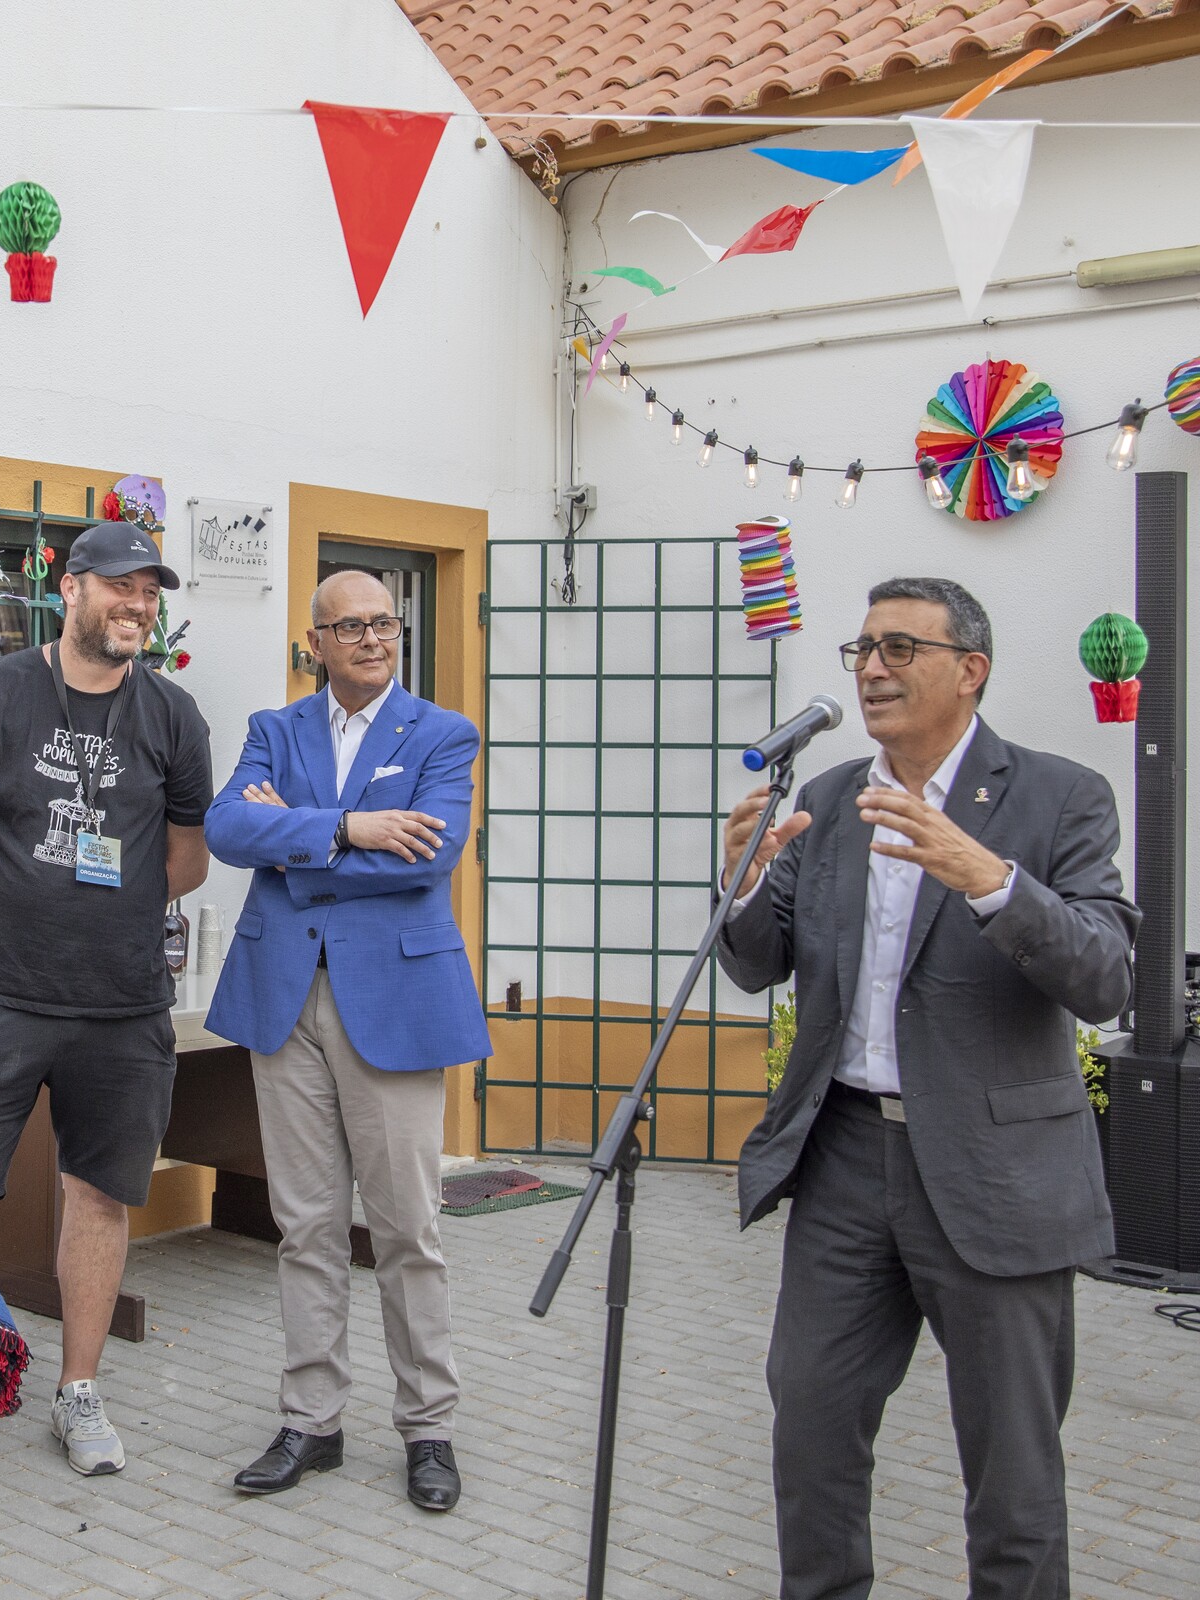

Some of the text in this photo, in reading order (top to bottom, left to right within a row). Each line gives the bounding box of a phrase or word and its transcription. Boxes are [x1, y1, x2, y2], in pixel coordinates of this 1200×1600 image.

[222, 534, 268, 551] FESTAS
[219, 556, 268, 566] POPULARES
[53, 728, 114, 755] FETAS
[42, 743, 119, 770] POPUAES
[37, 763, 77, 781] PINHAL
[80, 869, 117, 880] ORGANIZAÇÃO
